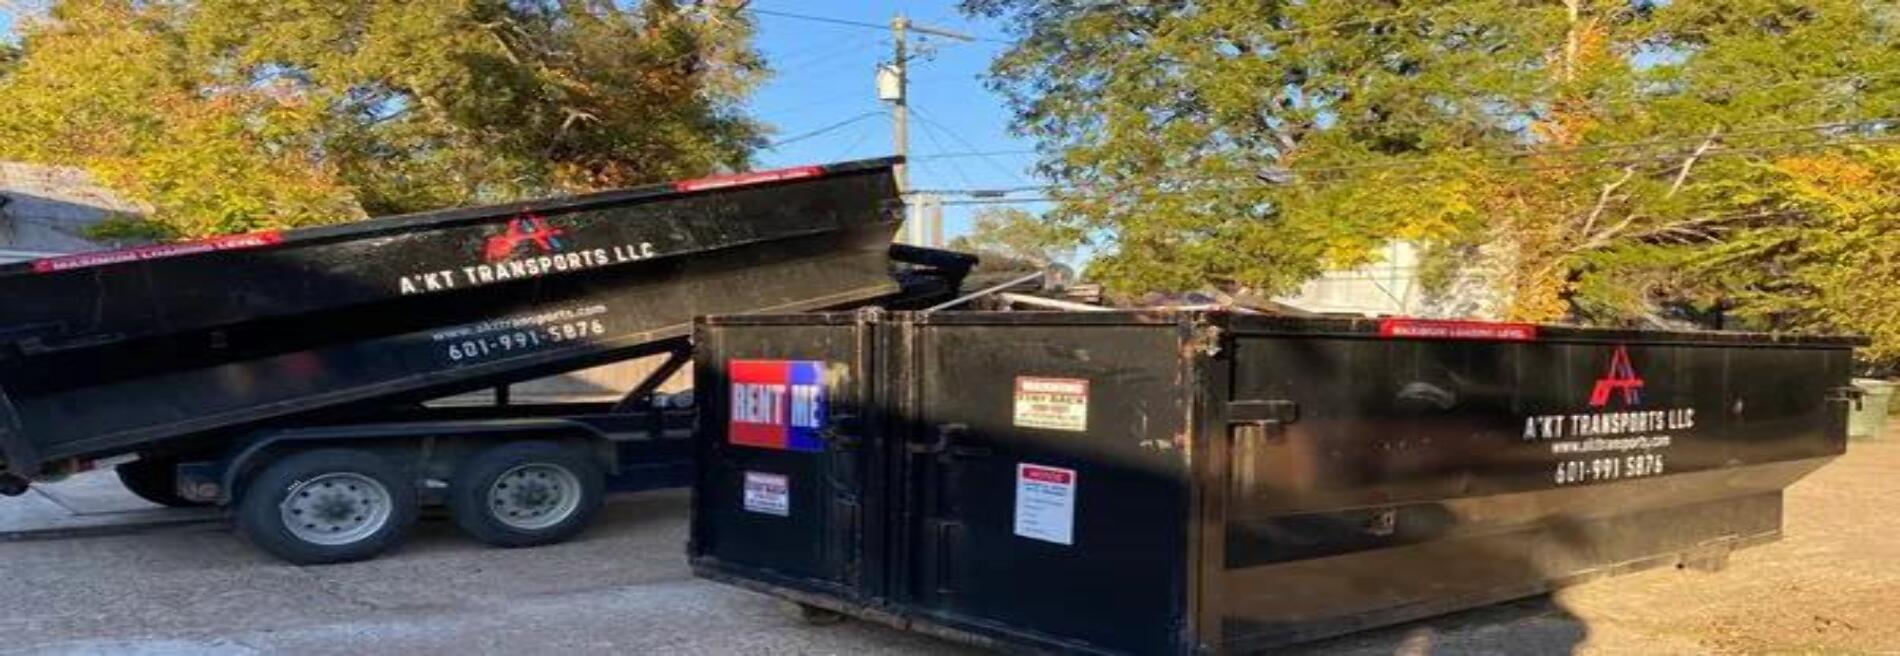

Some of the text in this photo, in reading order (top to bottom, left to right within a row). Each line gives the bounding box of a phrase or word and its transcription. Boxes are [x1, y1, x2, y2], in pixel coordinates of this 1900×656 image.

[463, 247, 610, 287] TRANSPORTS
[614, 241, 655, 263] LLC
[449, 318, 606, 361] 601-991-5876
[731, 383, 823, 428] RENT ME
[1570, 410, 1665, 437] TRANSPORTS
[1667, 407, 1696, 430] LLC
